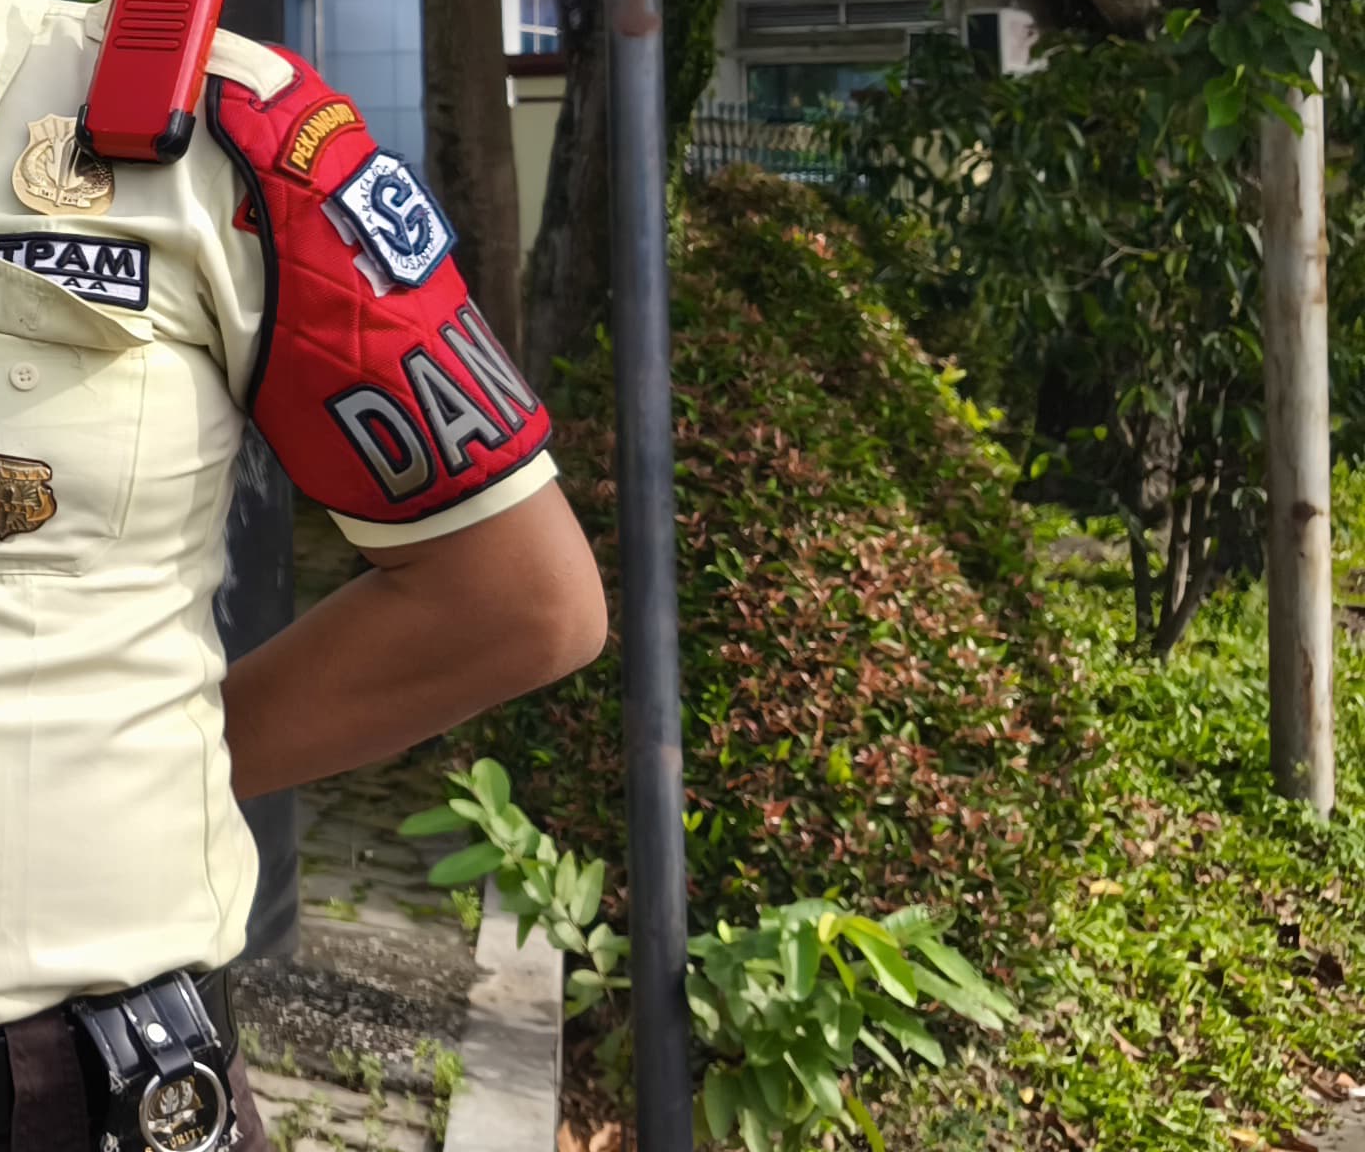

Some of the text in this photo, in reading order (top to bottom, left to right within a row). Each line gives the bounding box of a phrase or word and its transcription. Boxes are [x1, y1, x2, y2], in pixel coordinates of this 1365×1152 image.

[290, 102, 357, 170] PEKANBARU
[324, 298, 540, 504] DAN
[144, 1125, 205, 1152] URITY
